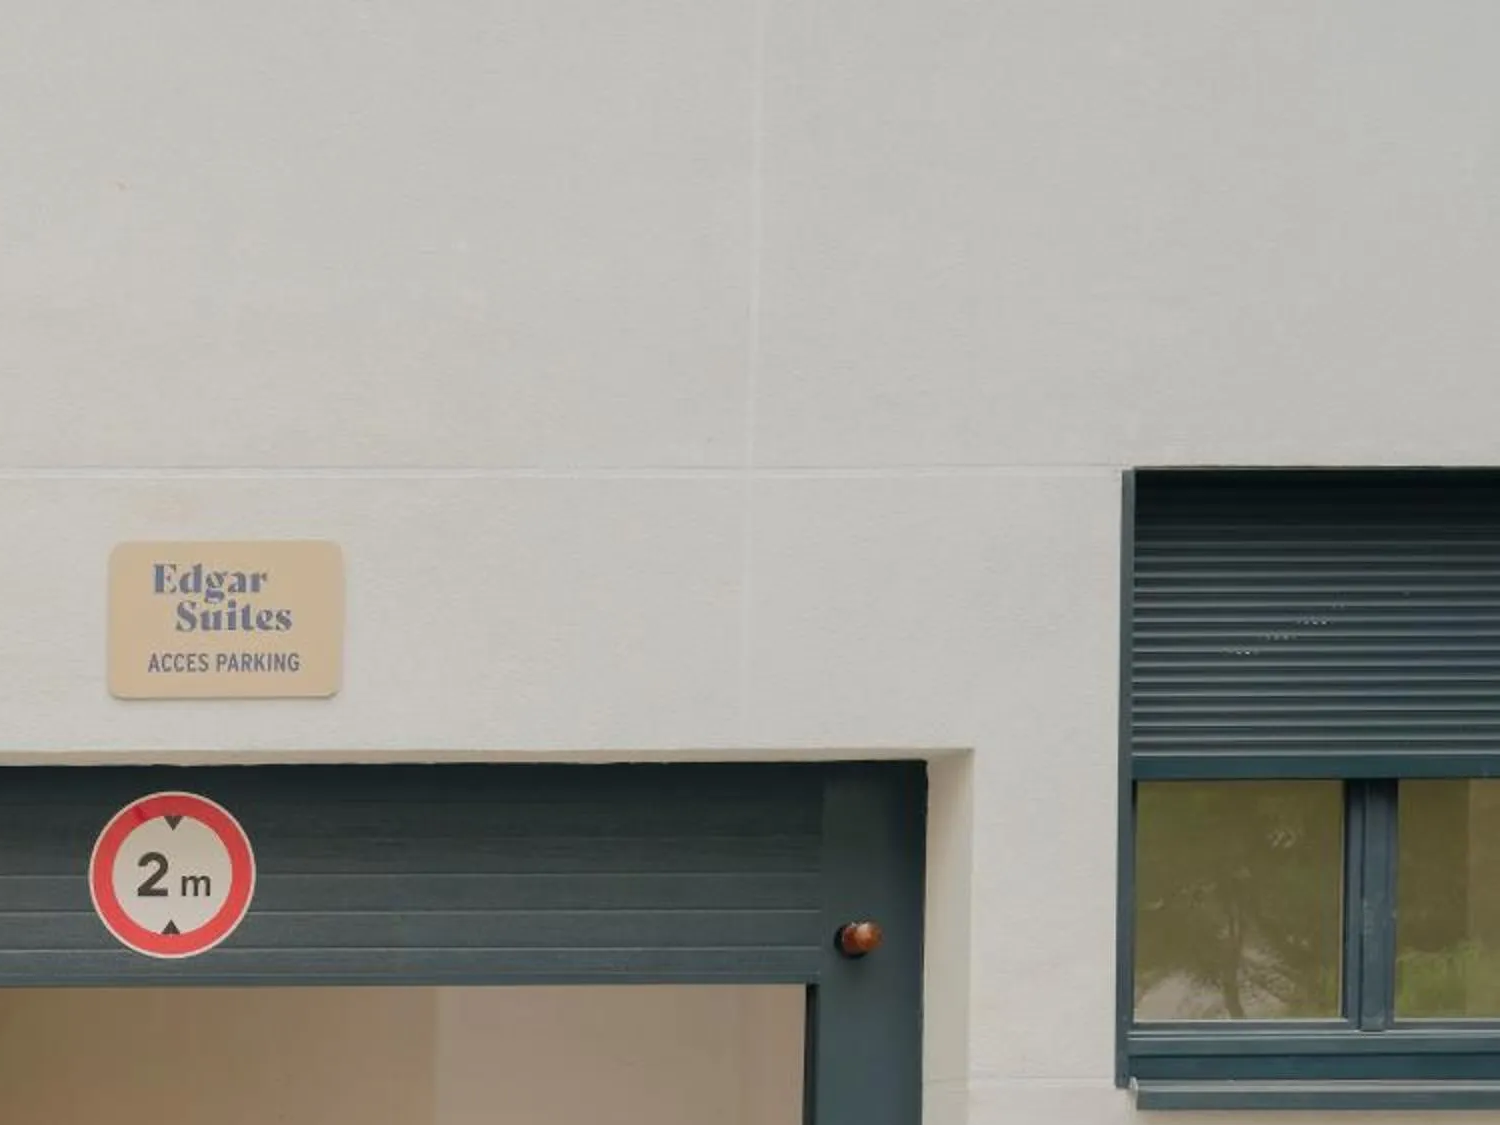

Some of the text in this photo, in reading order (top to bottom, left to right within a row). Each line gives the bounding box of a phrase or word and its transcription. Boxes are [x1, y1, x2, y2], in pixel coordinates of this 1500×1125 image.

[154, 563, 268, 604] Edgar
[175, 600, 293, 632] Suites
[148, 653, 300, 673] ACCES PARKING
[137, 852, 211, 897] 2 m
